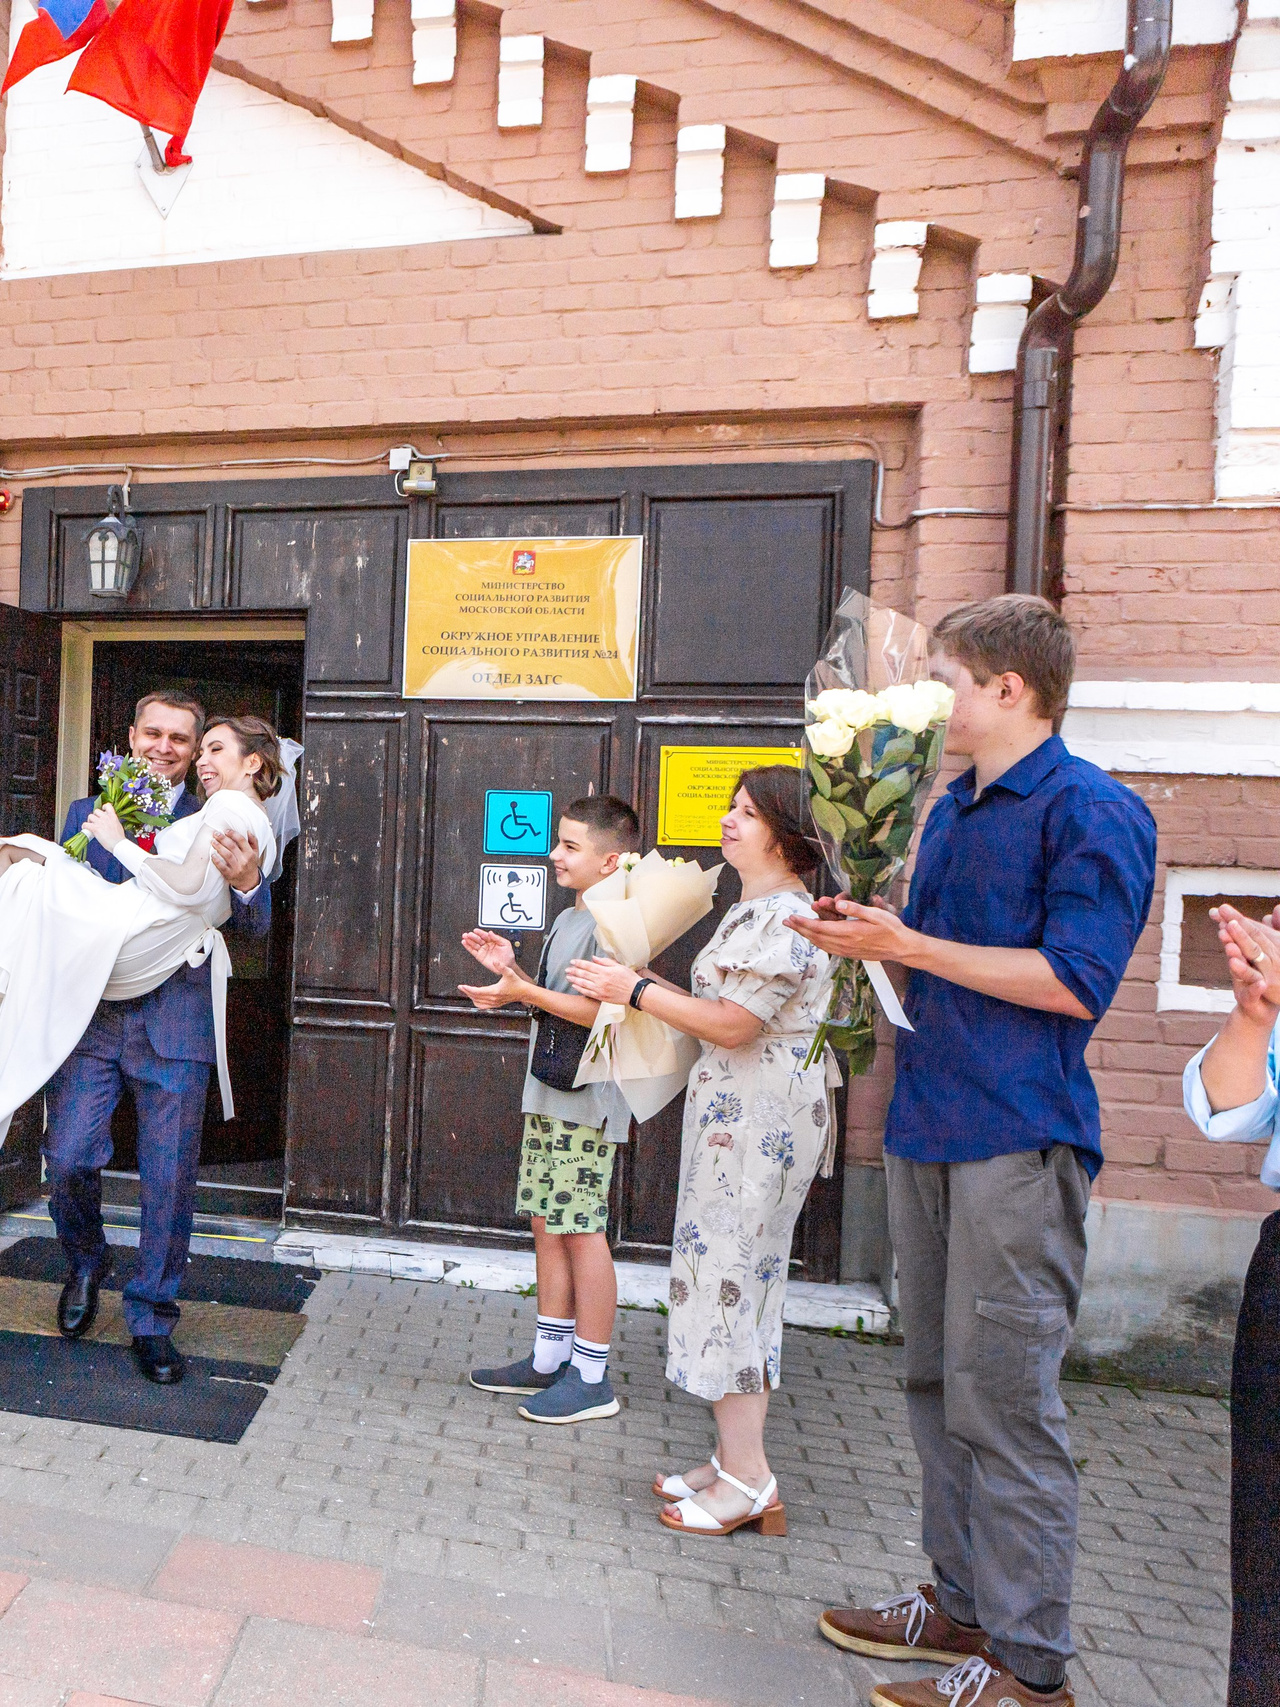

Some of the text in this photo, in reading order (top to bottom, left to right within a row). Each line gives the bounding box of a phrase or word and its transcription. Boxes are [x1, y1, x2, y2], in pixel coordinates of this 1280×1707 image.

[481, 581, 566, 591] МИНИСТЕРСТВО
[455, 593, 591, 603] СОЦИАЛЬНОГО РАЗВИТИЯ
[458, 605, 585, 616] МОСКОВСКОЙ ОБЛАСТИ
[440, 631, 601, 644] ОКРУЖНОЕ УПРАВЛЕНИЕ
[421, 645, 619, 660] СОЦИАЛЬНОГО РАЗВИТИЯ №24
[472, 672, 563, 686] ОТДЕЛ ЗАГС
